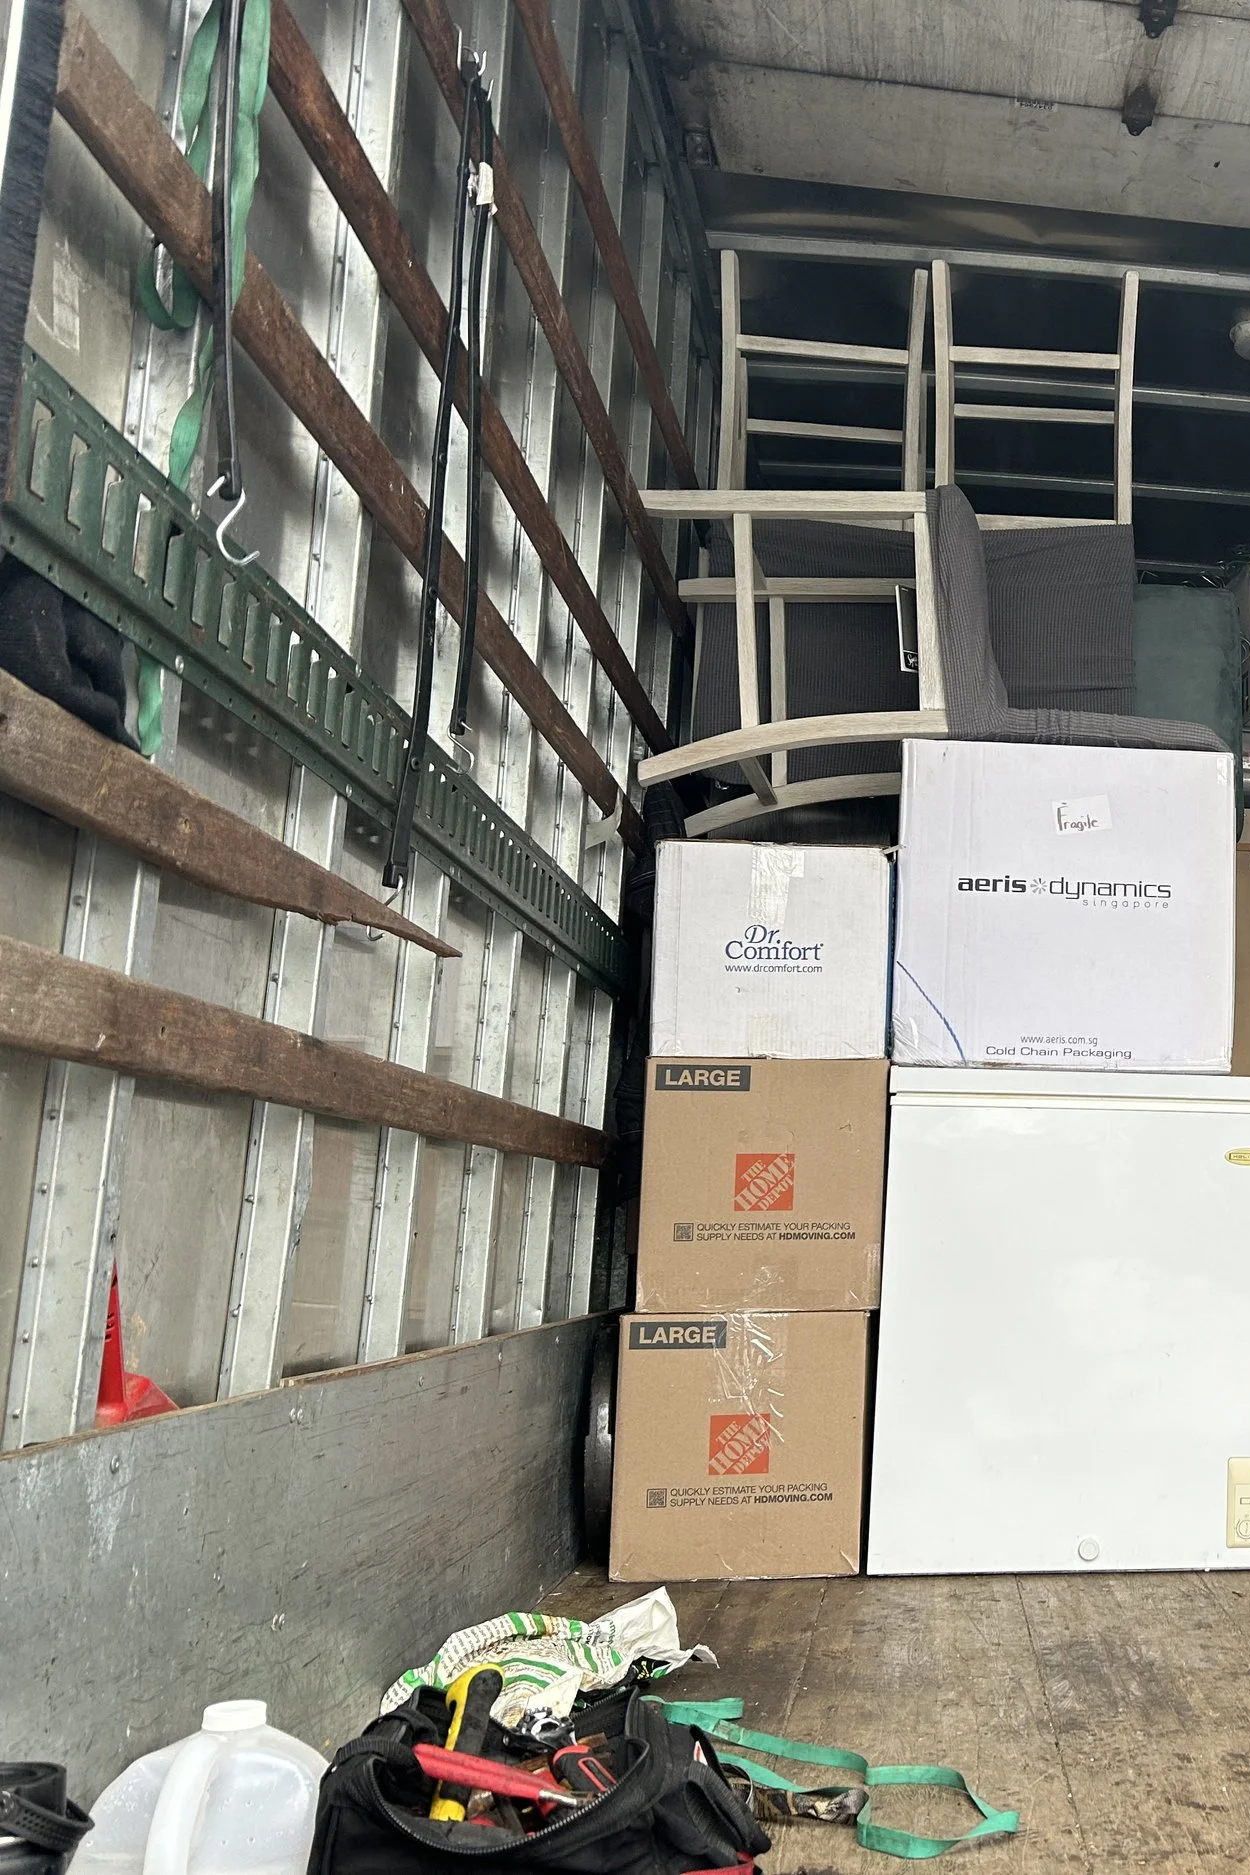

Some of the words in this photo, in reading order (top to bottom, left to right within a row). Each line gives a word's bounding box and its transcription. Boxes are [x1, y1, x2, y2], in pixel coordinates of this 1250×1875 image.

[1057, 802, 1100, 831] Fragile
[957, 875, 1027, 893] aeris
[1049, 877, 1172, 900] dynamics
[1082, 898, 1169, 909] singapore
[744, 924, 781, 944] Dr.
[725, 940, 822, 961] Comfort
[725, 964, 823, 974] www.drcomfort.com
[1020, 1035, 1098, 1047] www.aeris.com.sg
[986, 1046, 1016, 1056] Cold
[1020, 1046, 1058, 1056] Chain
[1063, 1047, 1132, 1059] Packaging
[665, 1069, 740, 1087] LARGE
[741, 1159, 766, 1183] THE
[733, 1154, 795, 1211] HOME
[757, 1174, 794, 1211] DEPOT
[697, 1223, 737, 1232] QUICKLY
[738, 1222, 781, 1231] ESTIMATE
[783, 1222, 809, 1231] YOUR
[811, 1222, 850, 1230] PACKING
[696, 1232, 732, 1241] SUPPLY
[734, 1232, 764, 1241] NEEDS
[766, 1232, 777, 1240] AT
[779, 1232, 856, 1241] HDMOVING.COM
[639, 1326, 717, 1344] LARGE
[715, 1420, 741, 1445] THE
[670, 1488, 710, 1497] QUICKLY
[712, 1486, 756, 1496] ESTIMATE
[758, 1484, 785, 1494] YOUR
[787, 1483, 828, 1493] PACKING
[670, 1497, 706, 1507] SUPPLY
[707, 1496, 739, 1506] NEEDS
[740, 1496, 752, 1505] AT
[754, 1493, 833, 1504] HDMOVING.COM
